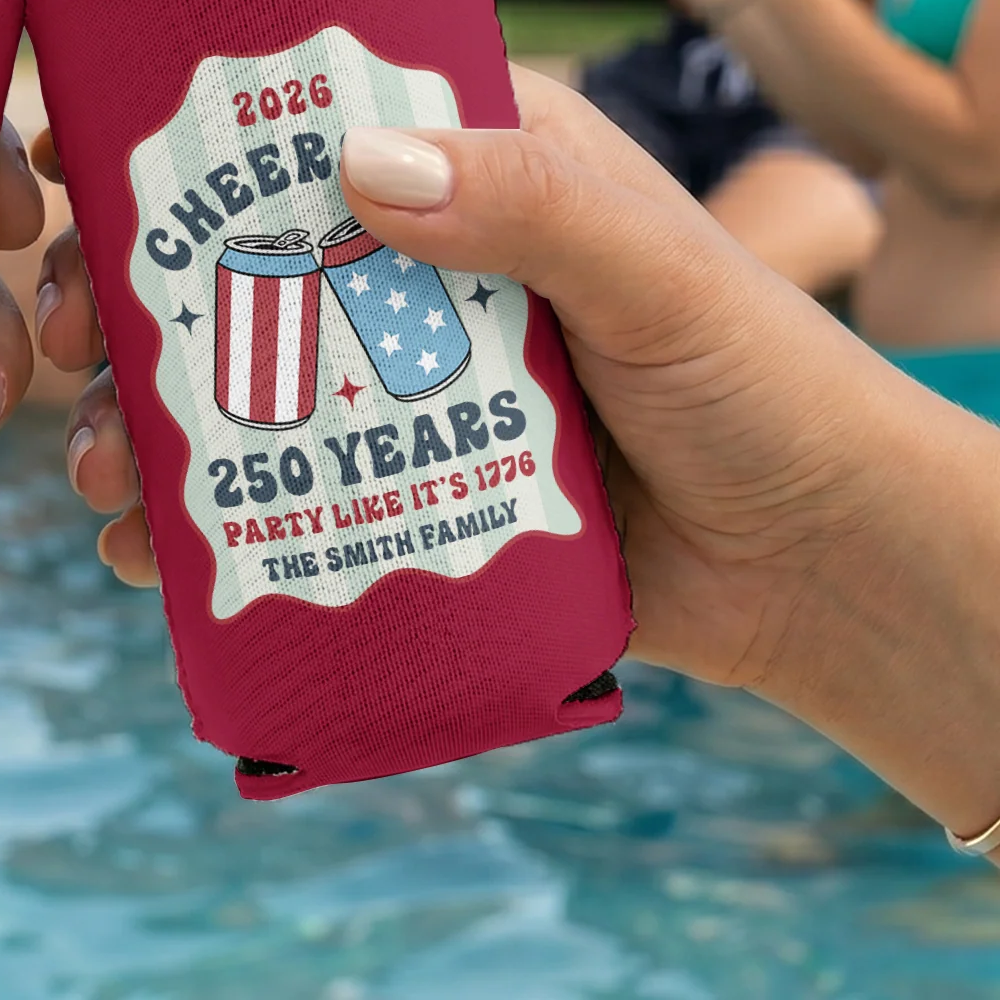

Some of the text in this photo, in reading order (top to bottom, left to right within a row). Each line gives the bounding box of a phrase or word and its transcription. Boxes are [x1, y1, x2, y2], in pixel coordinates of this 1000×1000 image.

[232, 73, 333, 127] 2026
[145, 131, 346, 271] CHEER
[208, 390, 527, 508] 250 YEARS
[223, 450, 537, 548] PARTY LIKE IT'S 1776
[262, 498, 519, 583] THE SMITH FAMILY
